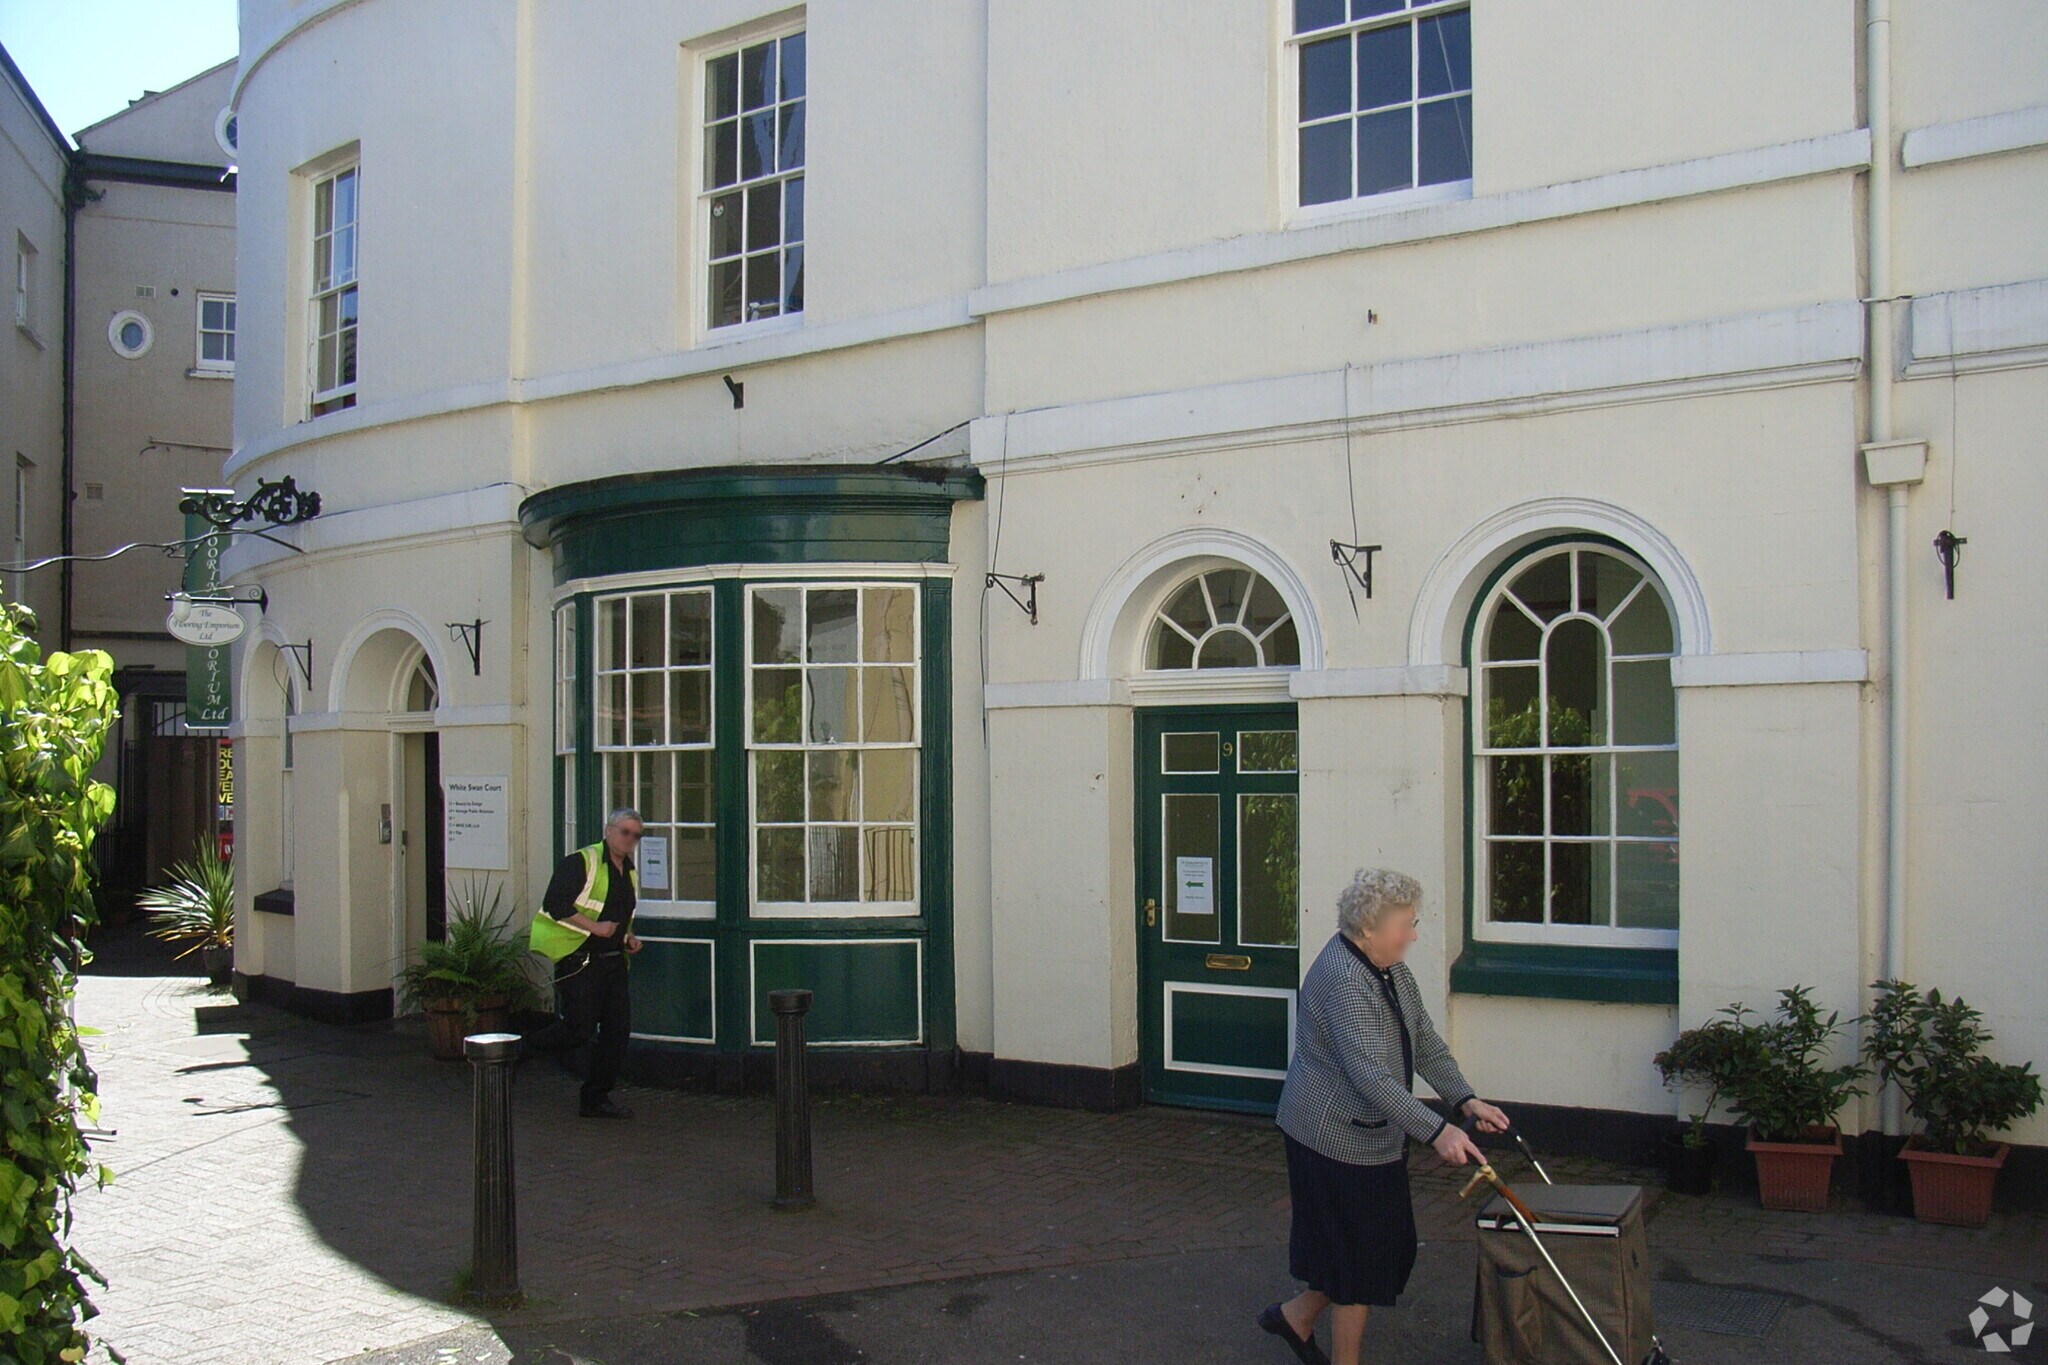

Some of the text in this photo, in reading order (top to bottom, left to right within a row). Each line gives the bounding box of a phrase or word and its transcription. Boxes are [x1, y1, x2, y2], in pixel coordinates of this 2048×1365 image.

[199, 608, 213, 617] The
[173, 619, 241, 632] Flooring Emporium
[199, 632, 214, 640] Ltd
[201, 706, 229, 720] Ltd
[1222, 741, 1233, 757] 9
[468, 784, 483, 792] Swan
[485, 784, 502, 792] Court
